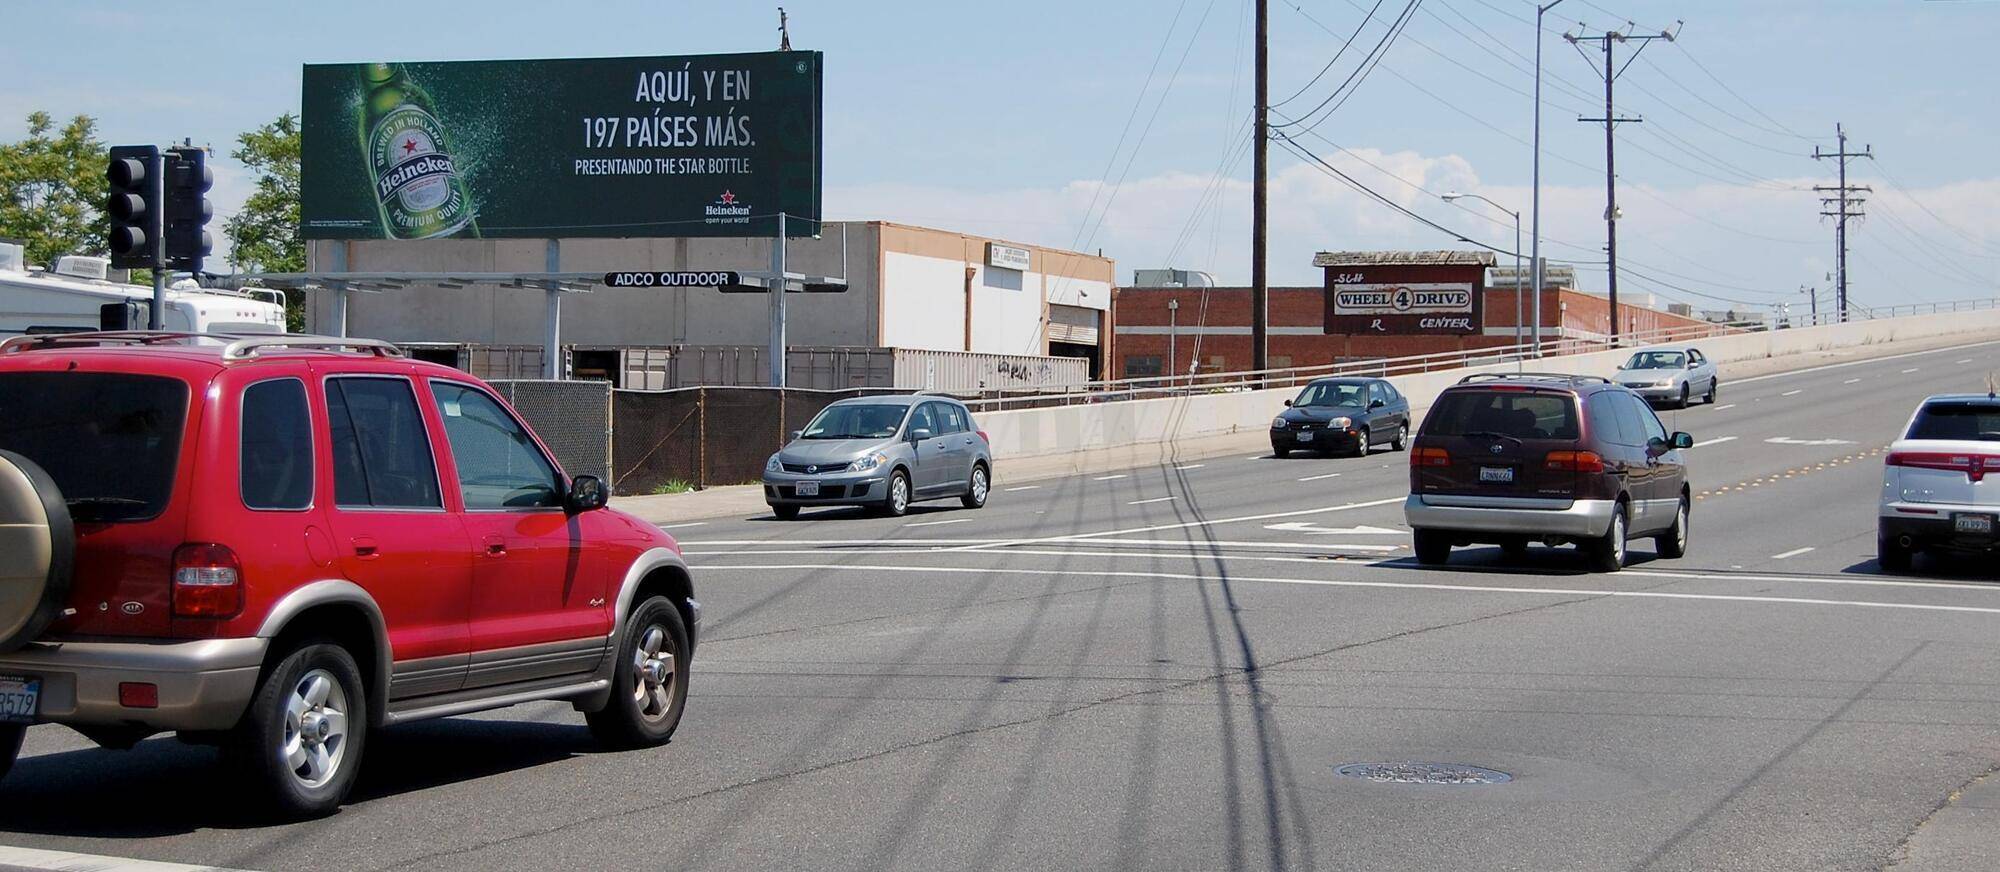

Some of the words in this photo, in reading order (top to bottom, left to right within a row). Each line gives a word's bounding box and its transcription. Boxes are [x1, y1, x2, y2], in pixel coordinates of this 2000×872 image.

[636, 62, 696, 107] AQUÍ,
[703, 70, 717, 101] Y
[723, 70, 750, 101] EN
[377, 125, 394, 167] BREWED
[394, 117, 405, 131] IN
[407, 116, 443, 147] HOLLAND
[583, 117, 620, 148] 197
[626, 107, 698, 148] PAÍSES
[705, 107, 756, 147] MÁS.
[380, 157, 454, 197] Heineken
[575, 158, 652, 175] PRESENTANDO
[655, 158, 676, 174] THE
[678, 158, 705, 174] STAR
[708, 158, 753, 174] BOTTLE.
[393, 208, 435, 227] PREMIUM
[437, 190, 462, 220] QUALITY
[614, 273, 654, 286] ADCO
[660, 272, 729, 286] OUTDOOR
[1340, 294, 1391, 305] WHEEL
[1396, 291, 1410, 307] 4
[1415, 293, 1467, 305] DRIVE
[1371, 318, 1386, 331] R
[1420, 317, 1474, 331] CENTER
